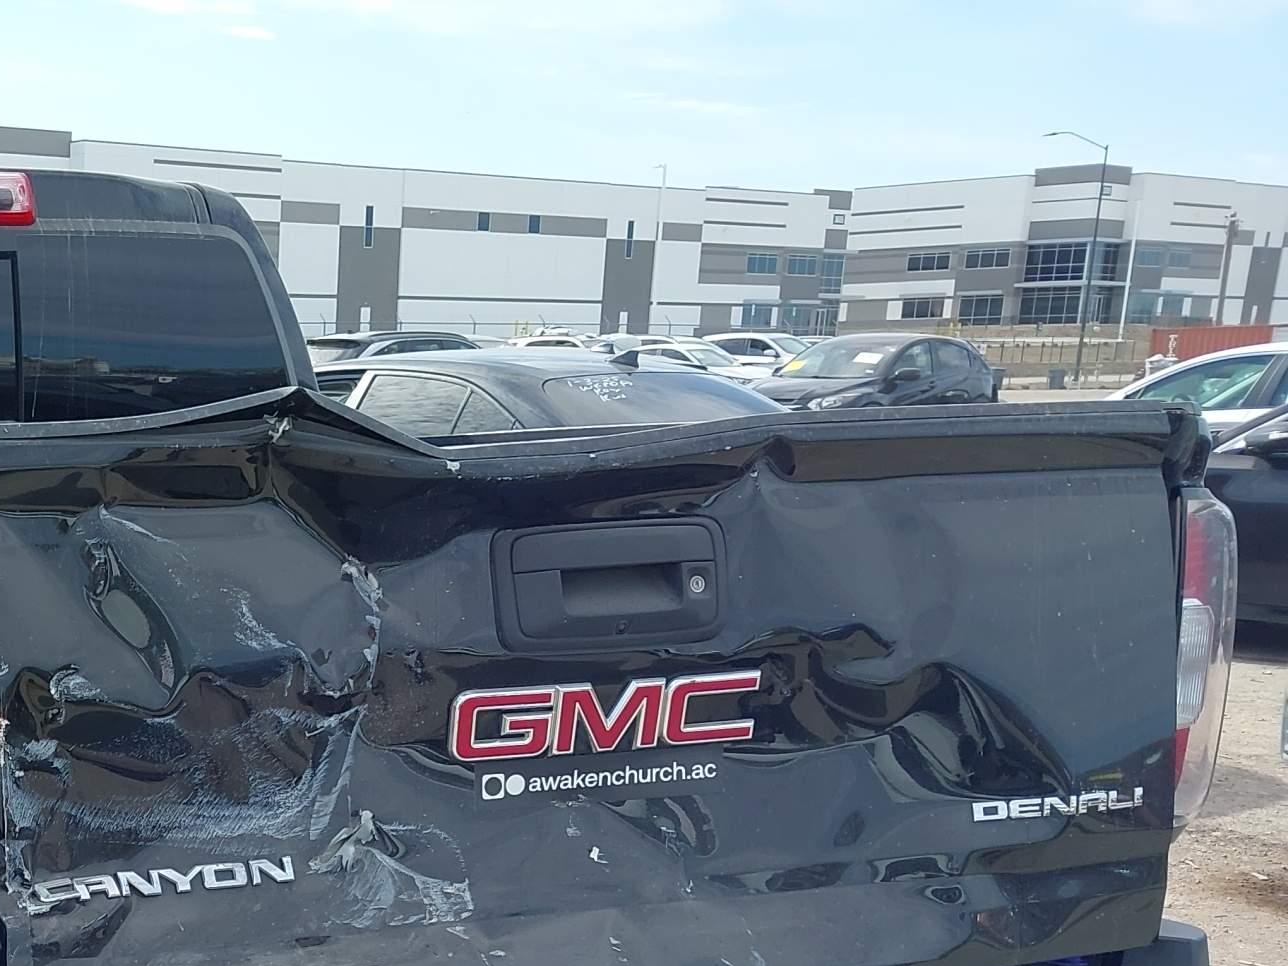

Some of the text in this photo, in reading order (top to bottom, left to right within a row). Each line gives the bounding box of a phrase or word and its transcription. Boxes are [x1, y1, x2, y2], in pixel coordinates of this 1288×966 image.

[448, 669, 761, 761] GMC
[528, 761, 717, 793] awakenchurch.ac
[972, 786, 1144, 822] DENALI
[32, 855, 296, 902] CANYON
